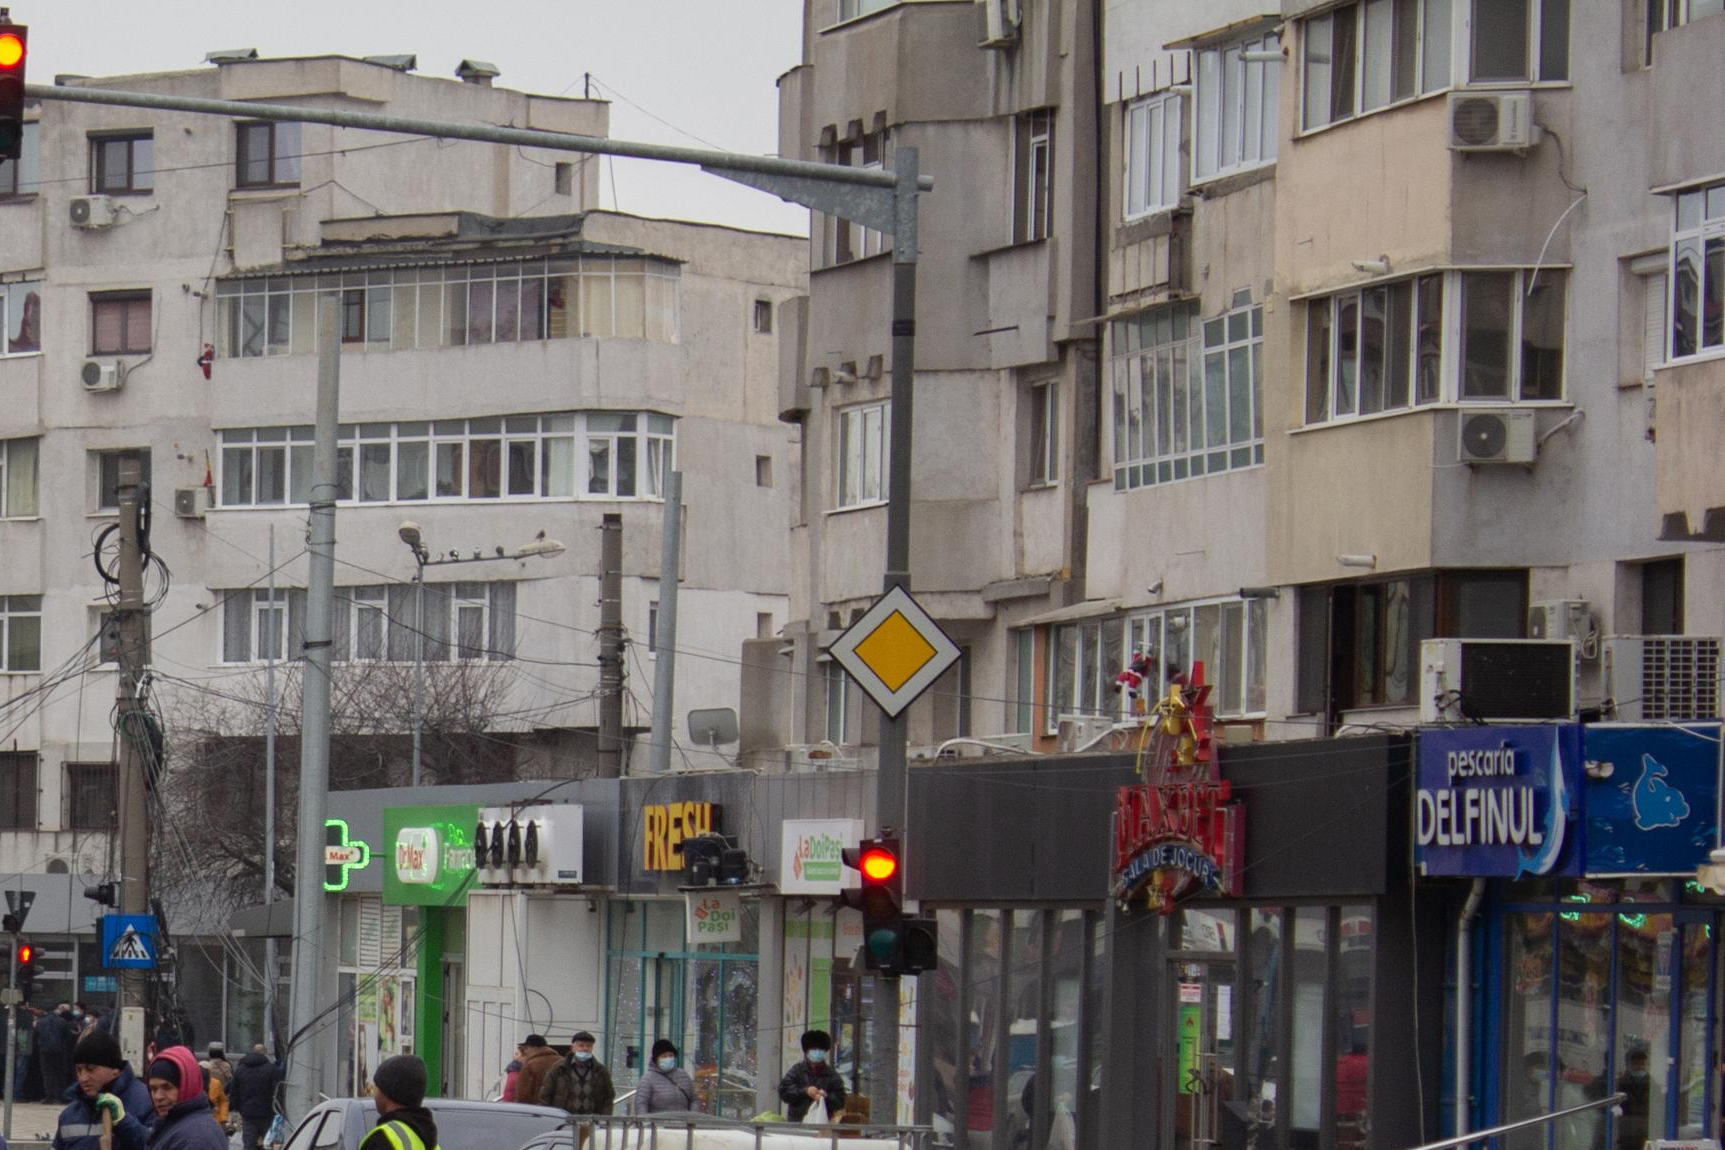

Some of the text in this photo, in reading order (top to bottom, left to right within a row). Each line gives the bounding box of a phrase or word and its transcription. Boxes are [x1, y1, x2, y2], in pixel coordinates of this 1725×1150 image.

[643, 801, 712, 871] FRESH
[1417, 786, 1543, 846] DELFINUL
[1153, 846, 1168, 867] DE
[710, 907, 735, 922] Doi
